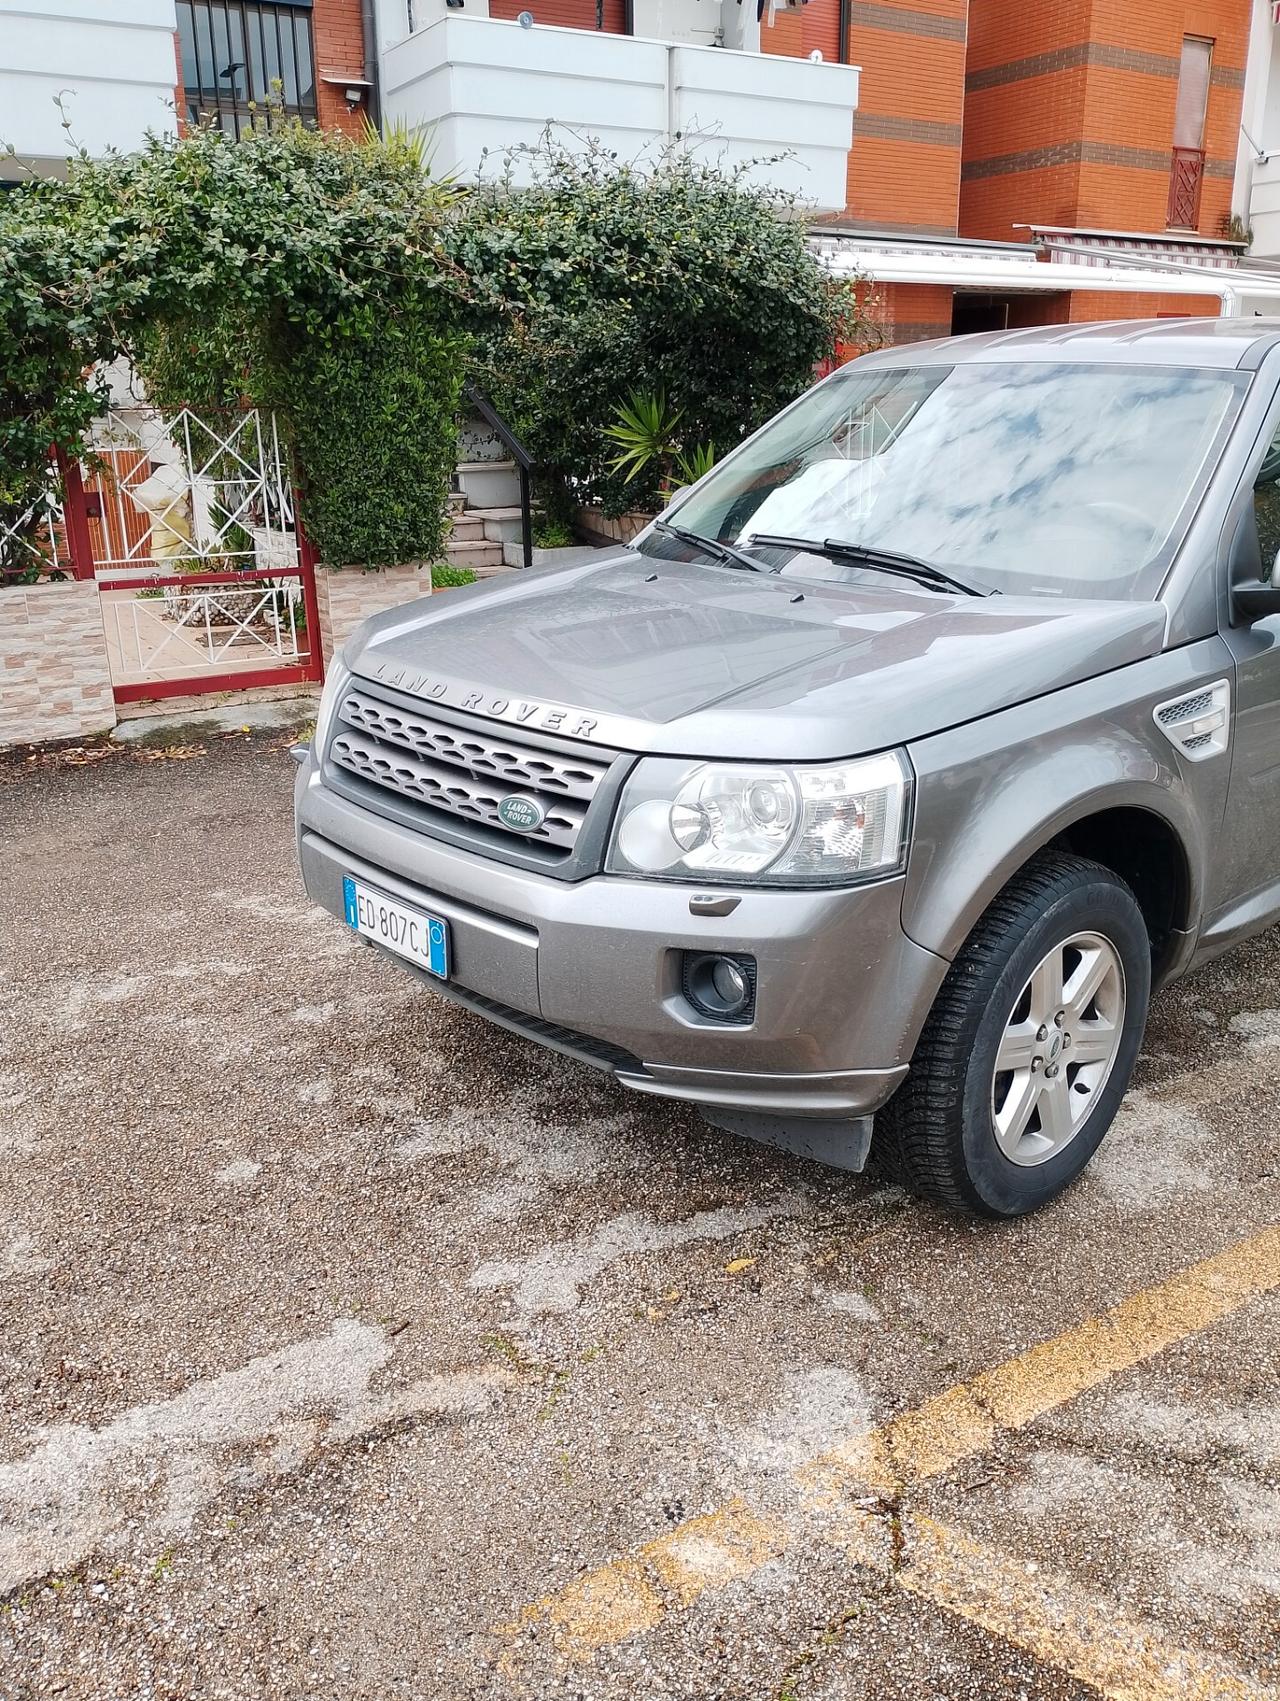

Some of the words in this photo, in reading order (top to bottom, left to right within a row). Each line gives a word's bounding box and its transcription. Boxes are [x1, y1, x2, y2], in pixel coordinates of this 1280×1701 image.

[372, 663, 448, 698] LAND
[461, 690, 598, 737] ROVER
[507, 801, 528, 814] LAND
[507, 811, 532, 825] ROVER
[357, 895, 376, 930] ED
